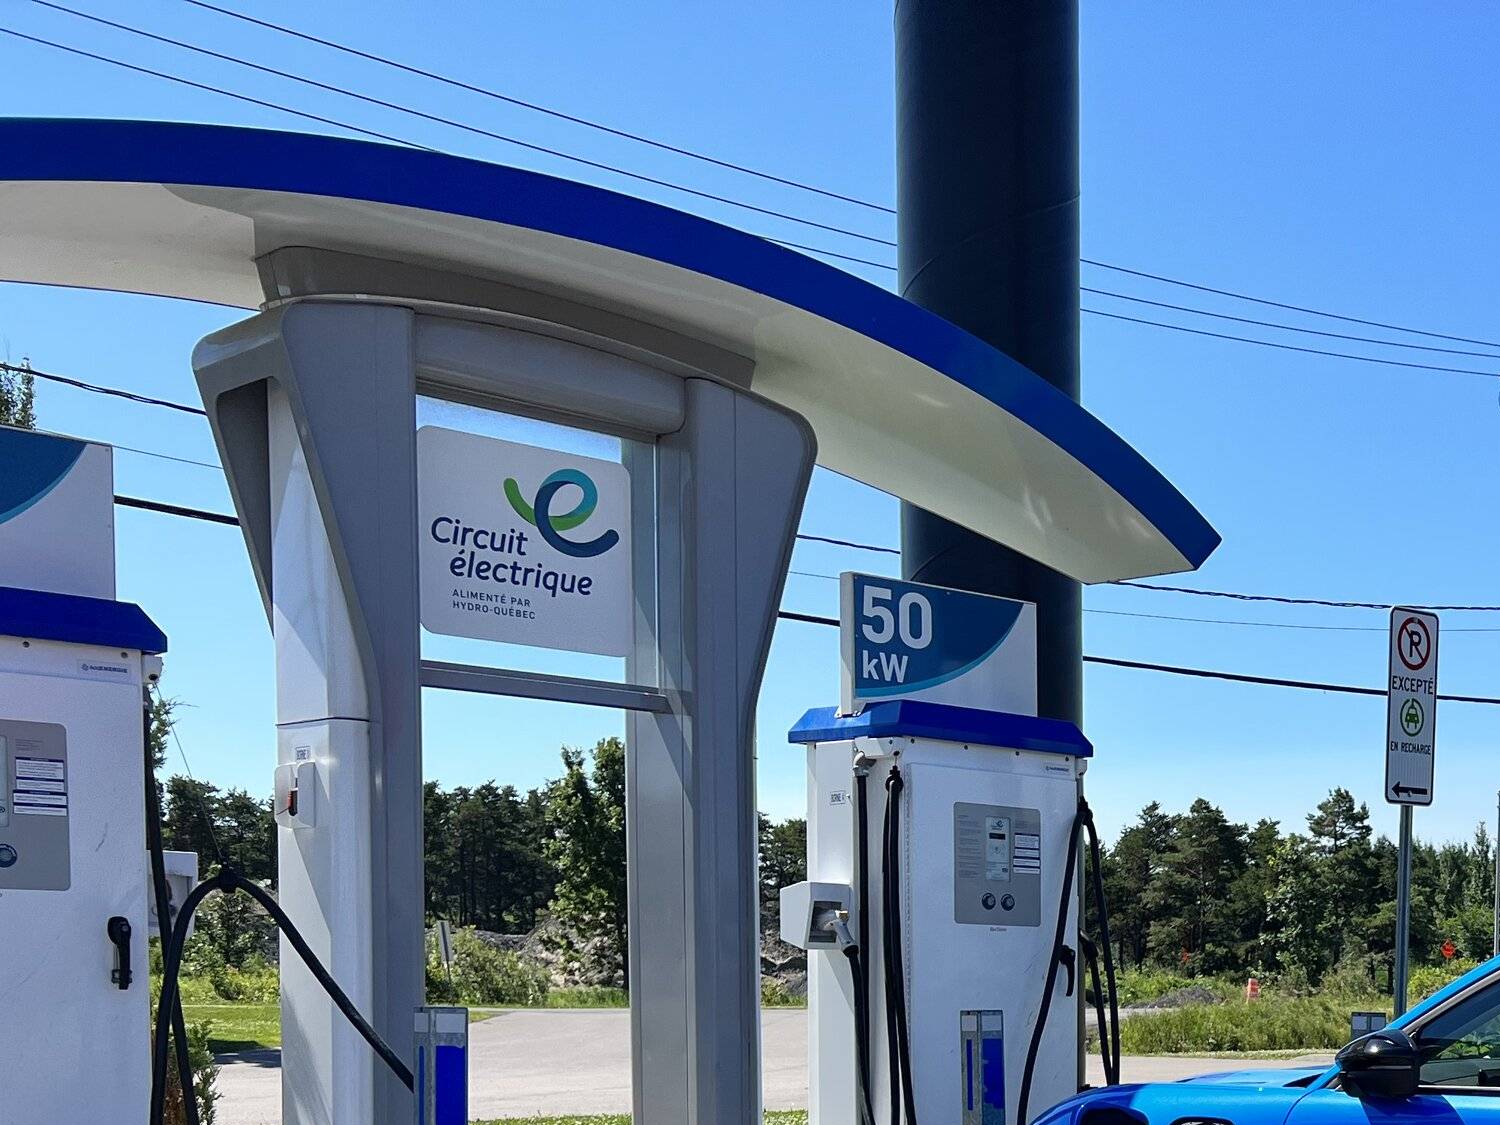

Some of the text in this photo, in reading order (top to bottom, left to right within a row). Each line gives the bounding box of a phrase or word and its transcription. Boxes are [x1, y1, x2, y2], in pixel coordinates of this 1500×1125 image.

[431, 516, 529, 556] Circuit
[450, 549, 593, 598] électrique
[452, 588, 531, 608] ALIMENTÉ PAR
[452, 600, 536, 620] HYDRO-QUÉBEC
[862, 585, 933, 650] 50
[862, 650, 909, 684] kW
[1391, 675, 1434, 696] EXCEPTÉ
[1390, 741, 1432, 755] EN RECHARGE
